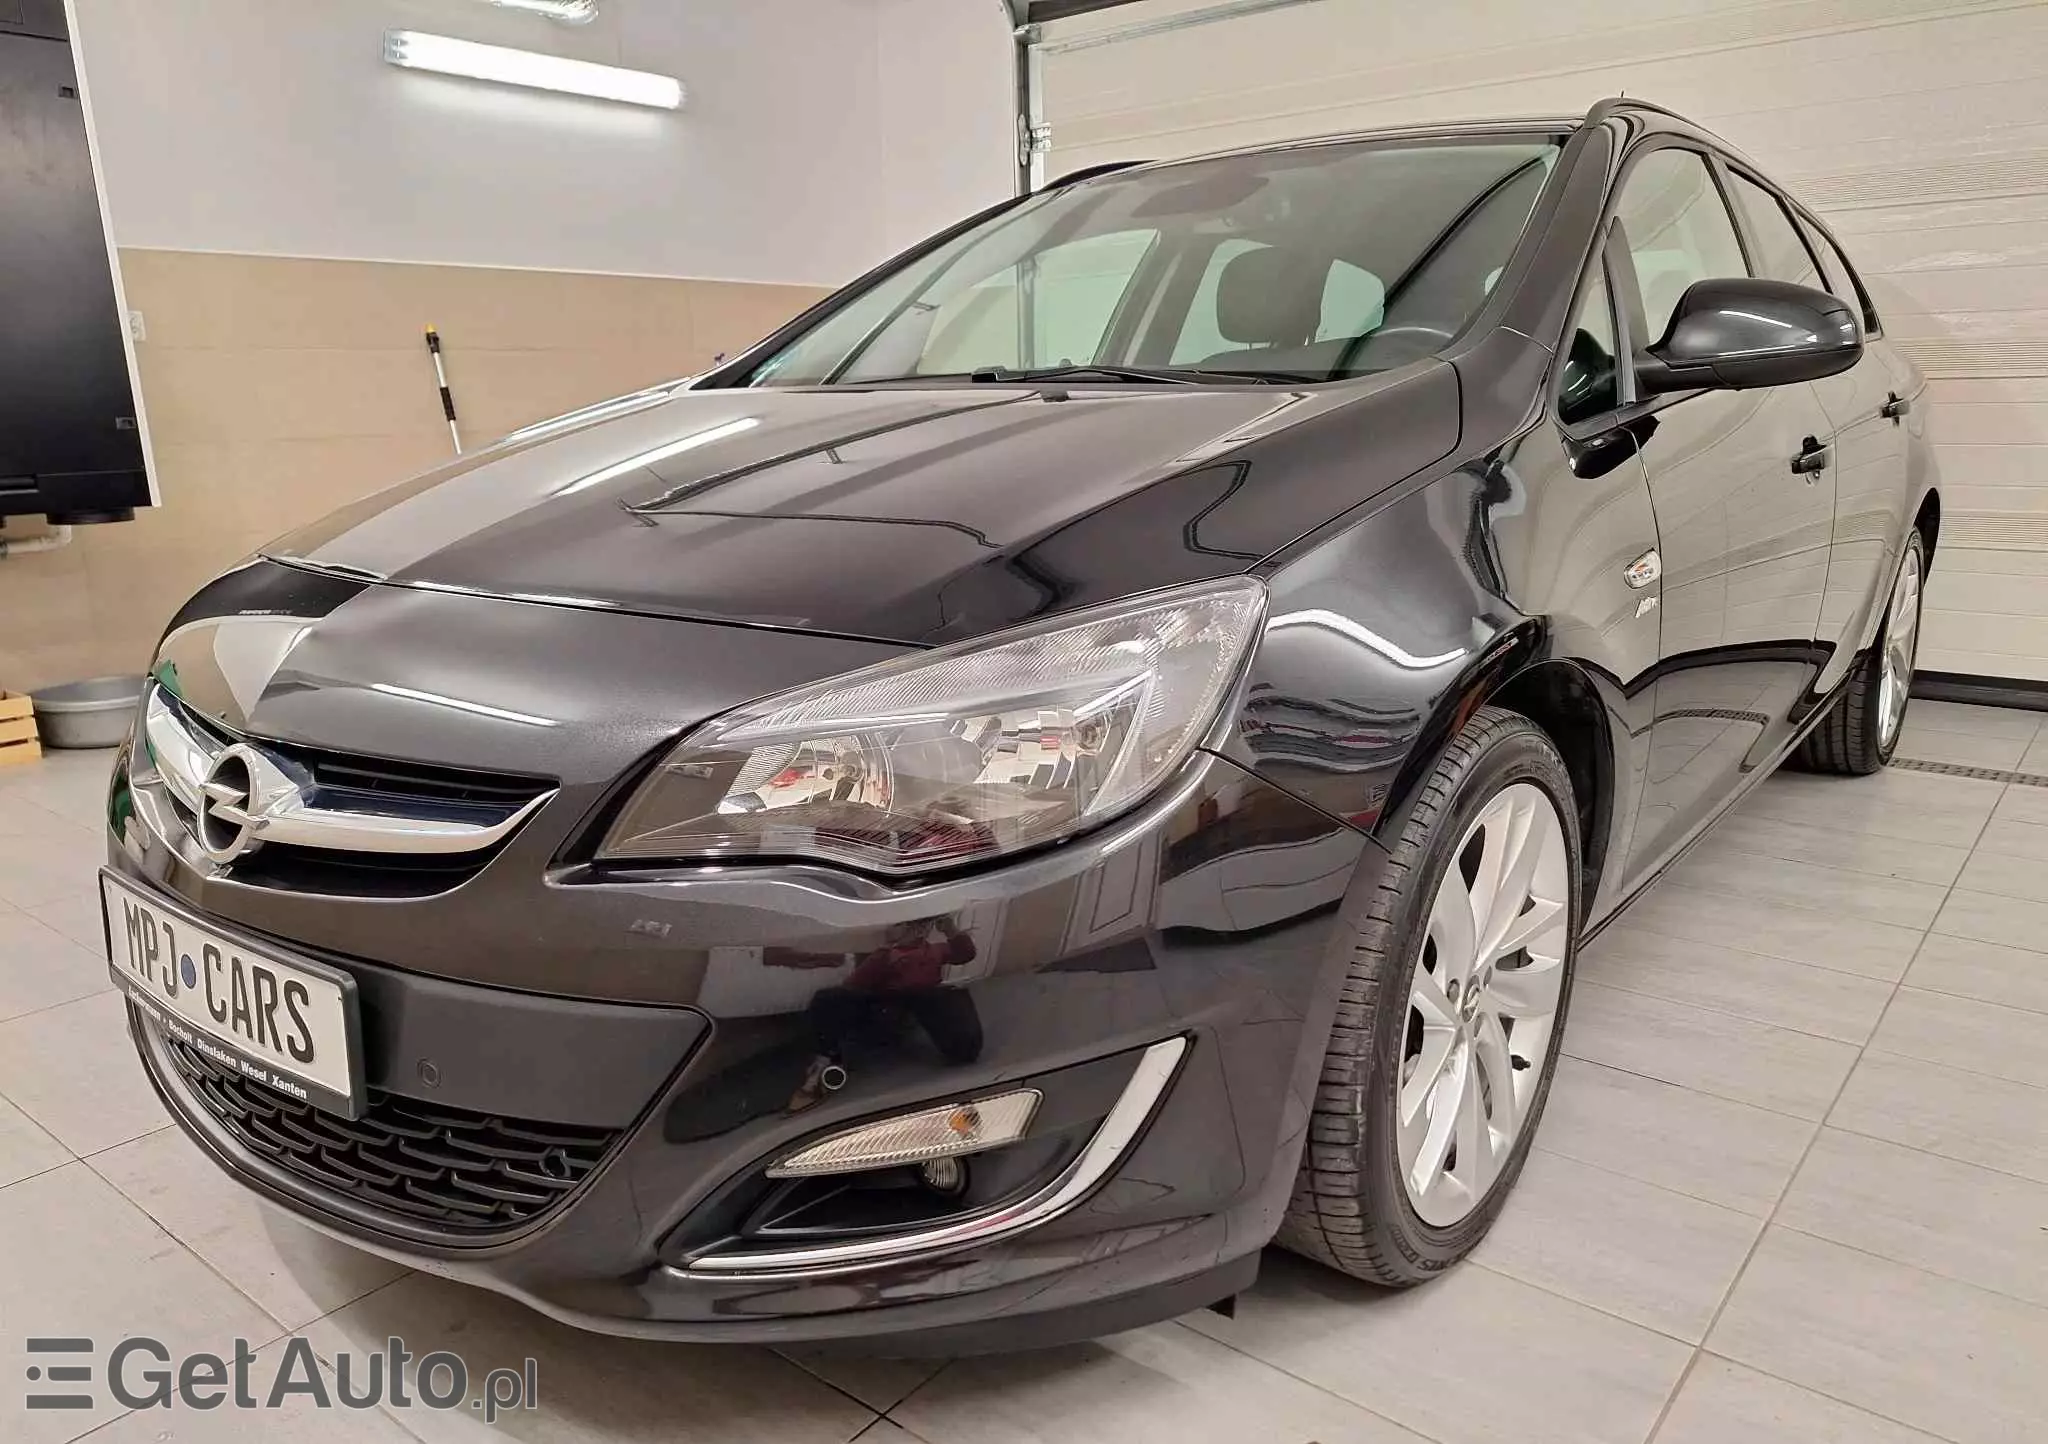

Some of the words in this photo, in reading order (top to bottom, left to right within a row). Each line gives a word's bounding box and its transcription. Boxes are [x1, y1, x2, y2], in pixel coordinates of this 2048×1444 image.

[122, 897, 178, 999] MPJ
[202, 943, 315, 1064] CARS
[197, 1032, 237, 1068] Dinslaken
[241, 1059, 267, 1083] Wesel
[272, 1075, 307, 1099] Xanten
